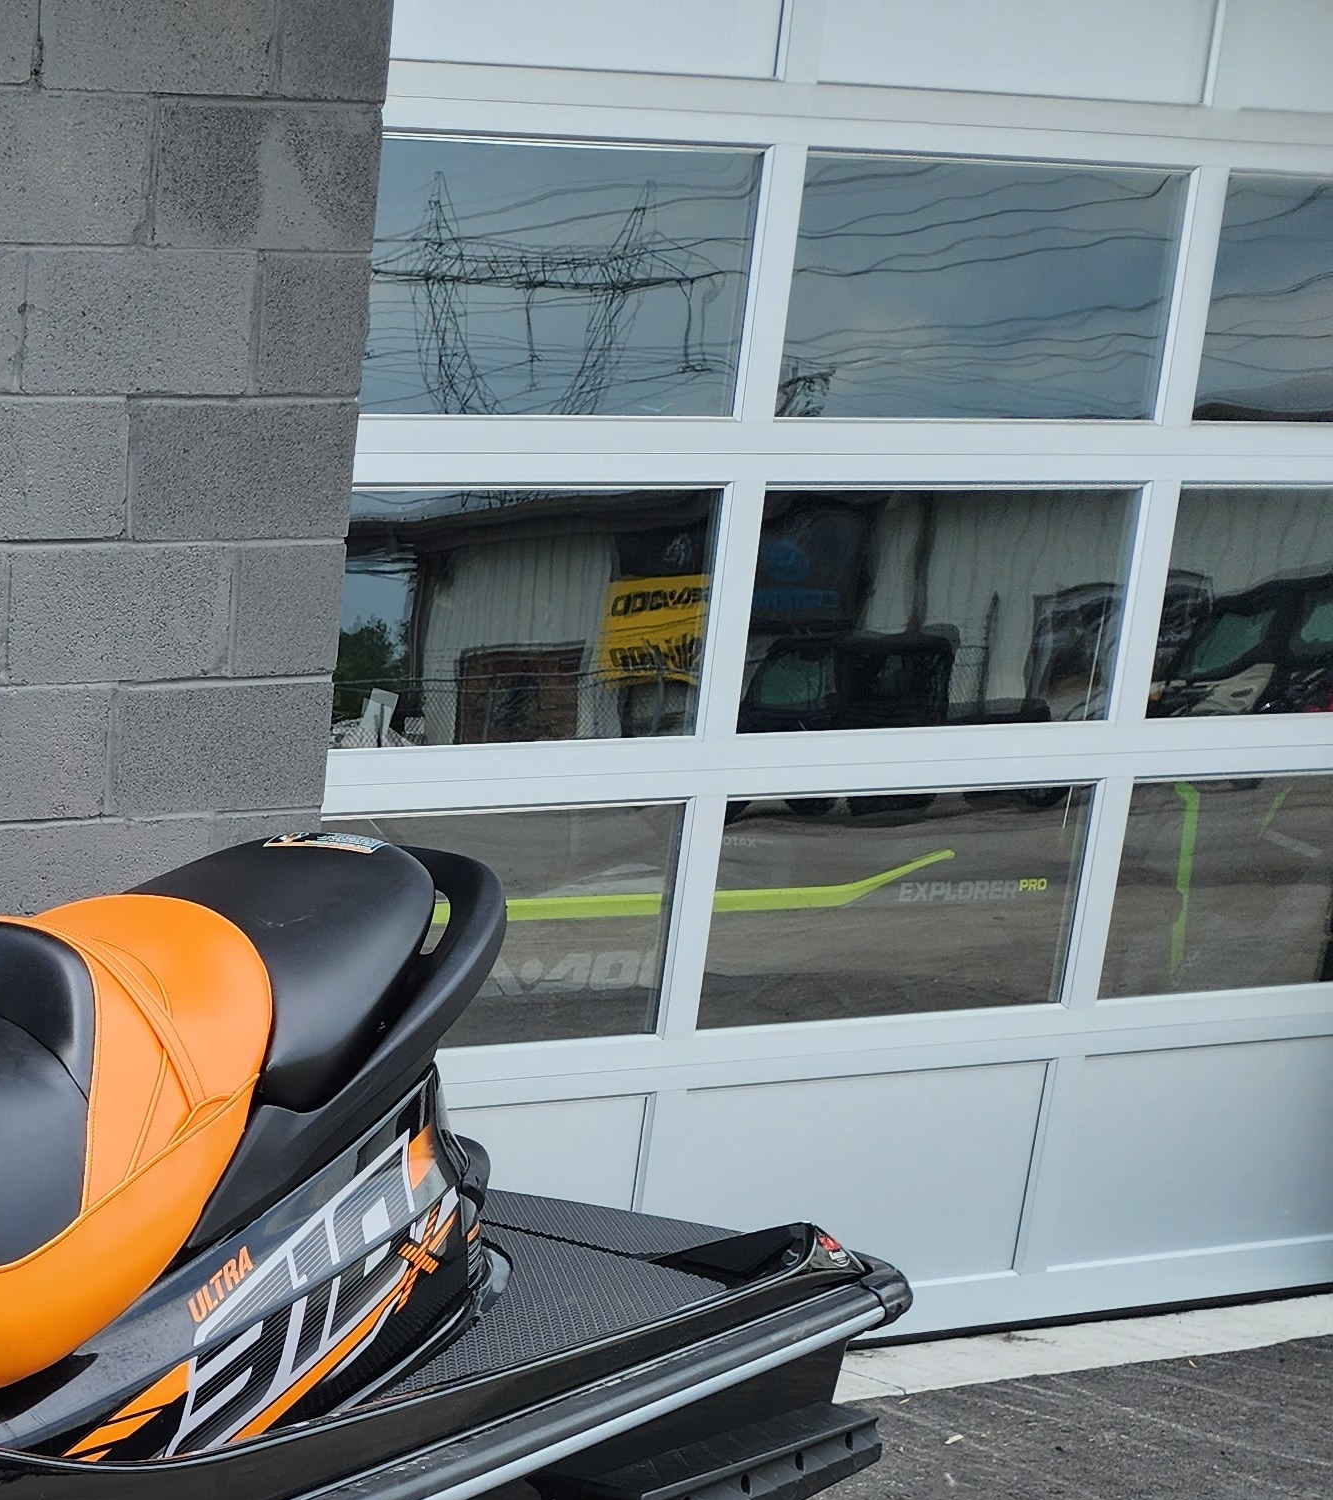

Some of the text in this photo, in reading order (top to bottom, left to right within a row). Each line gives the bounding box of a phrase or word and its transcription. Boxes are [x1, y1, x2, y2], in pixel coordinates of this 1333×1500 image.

[898, 878, 1048, 902] EXPLORER PRO
[186, 1245, 256, 1324] ULTRA
